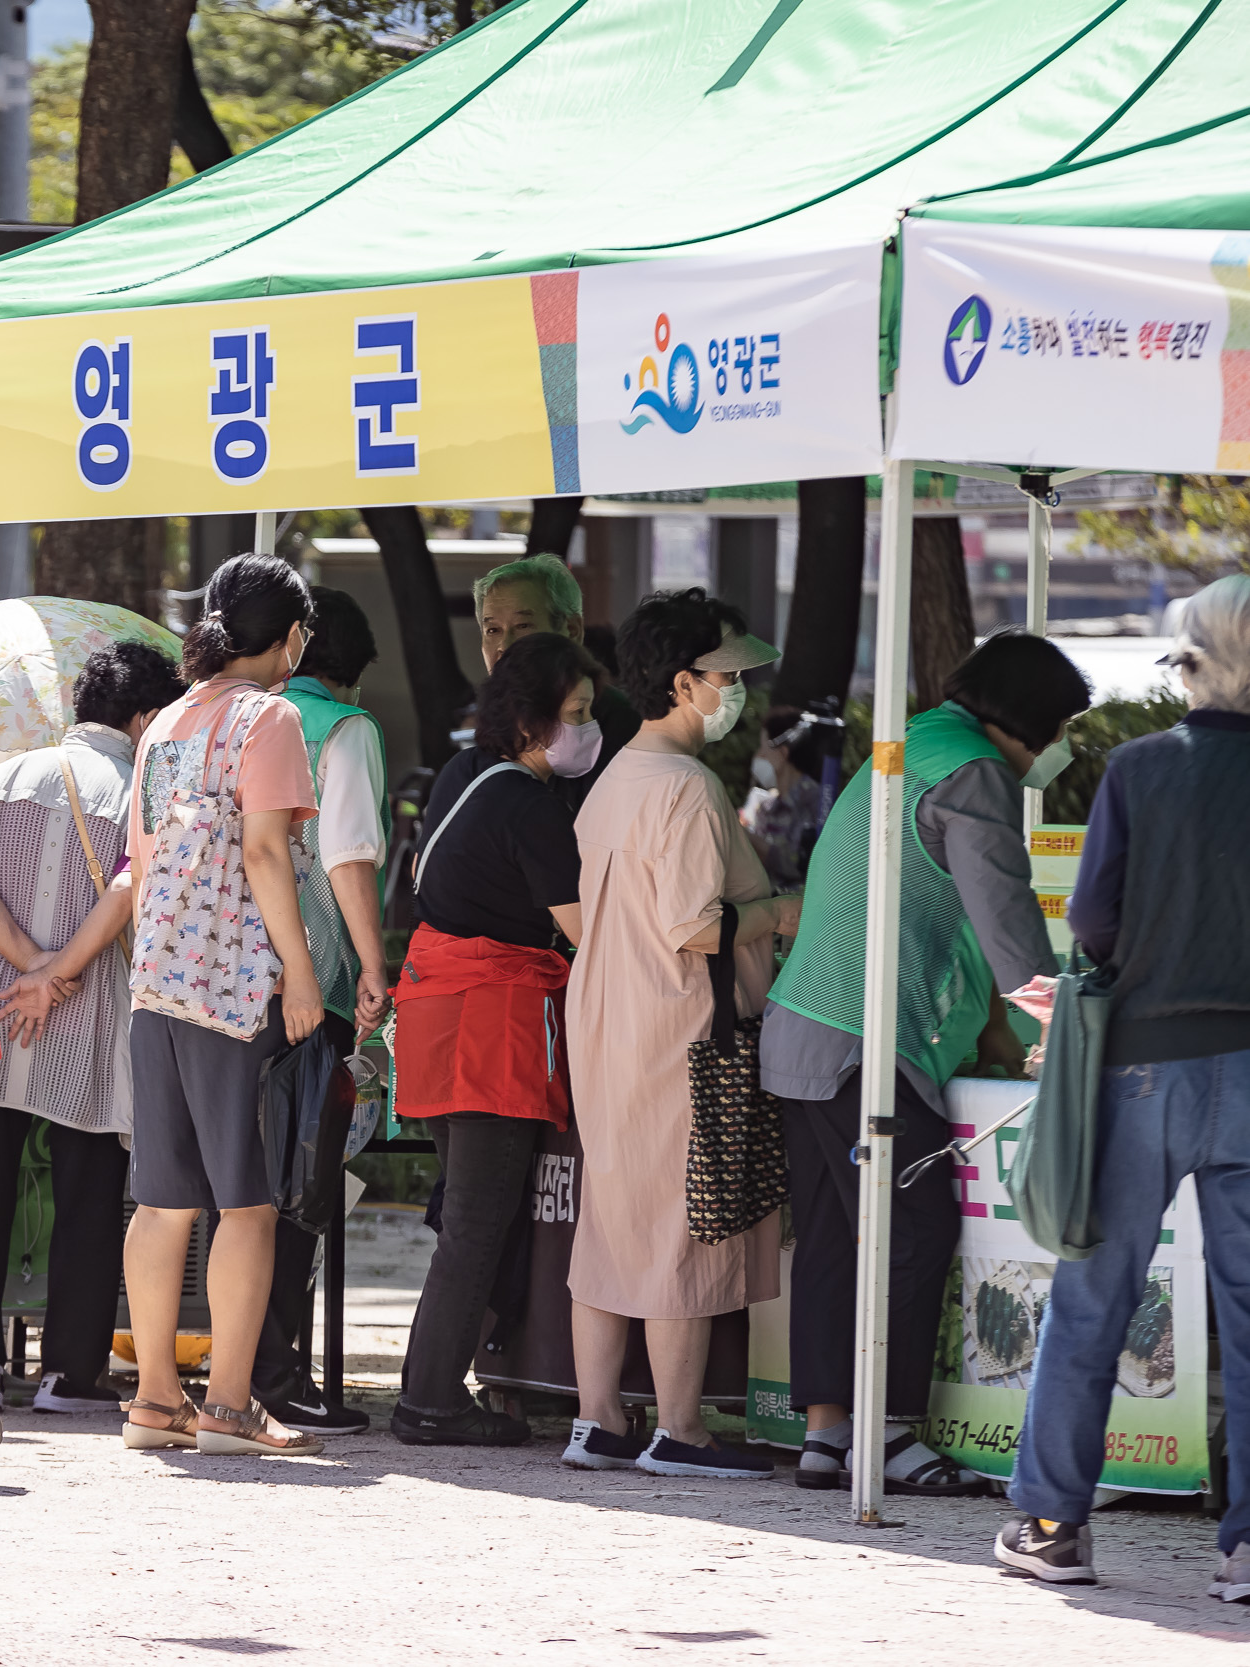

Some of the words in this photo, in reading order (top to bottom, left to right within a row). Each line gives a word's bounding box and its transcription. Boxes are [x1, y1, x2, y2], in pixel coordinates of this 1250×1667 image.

[1000, 307, 1063, 357] 소통하며
[1066, 308, 1129, 359] 발전하는
[1137, 319, 1211, 361] 행복광진
[708, 332, 781, 396] 영광군
